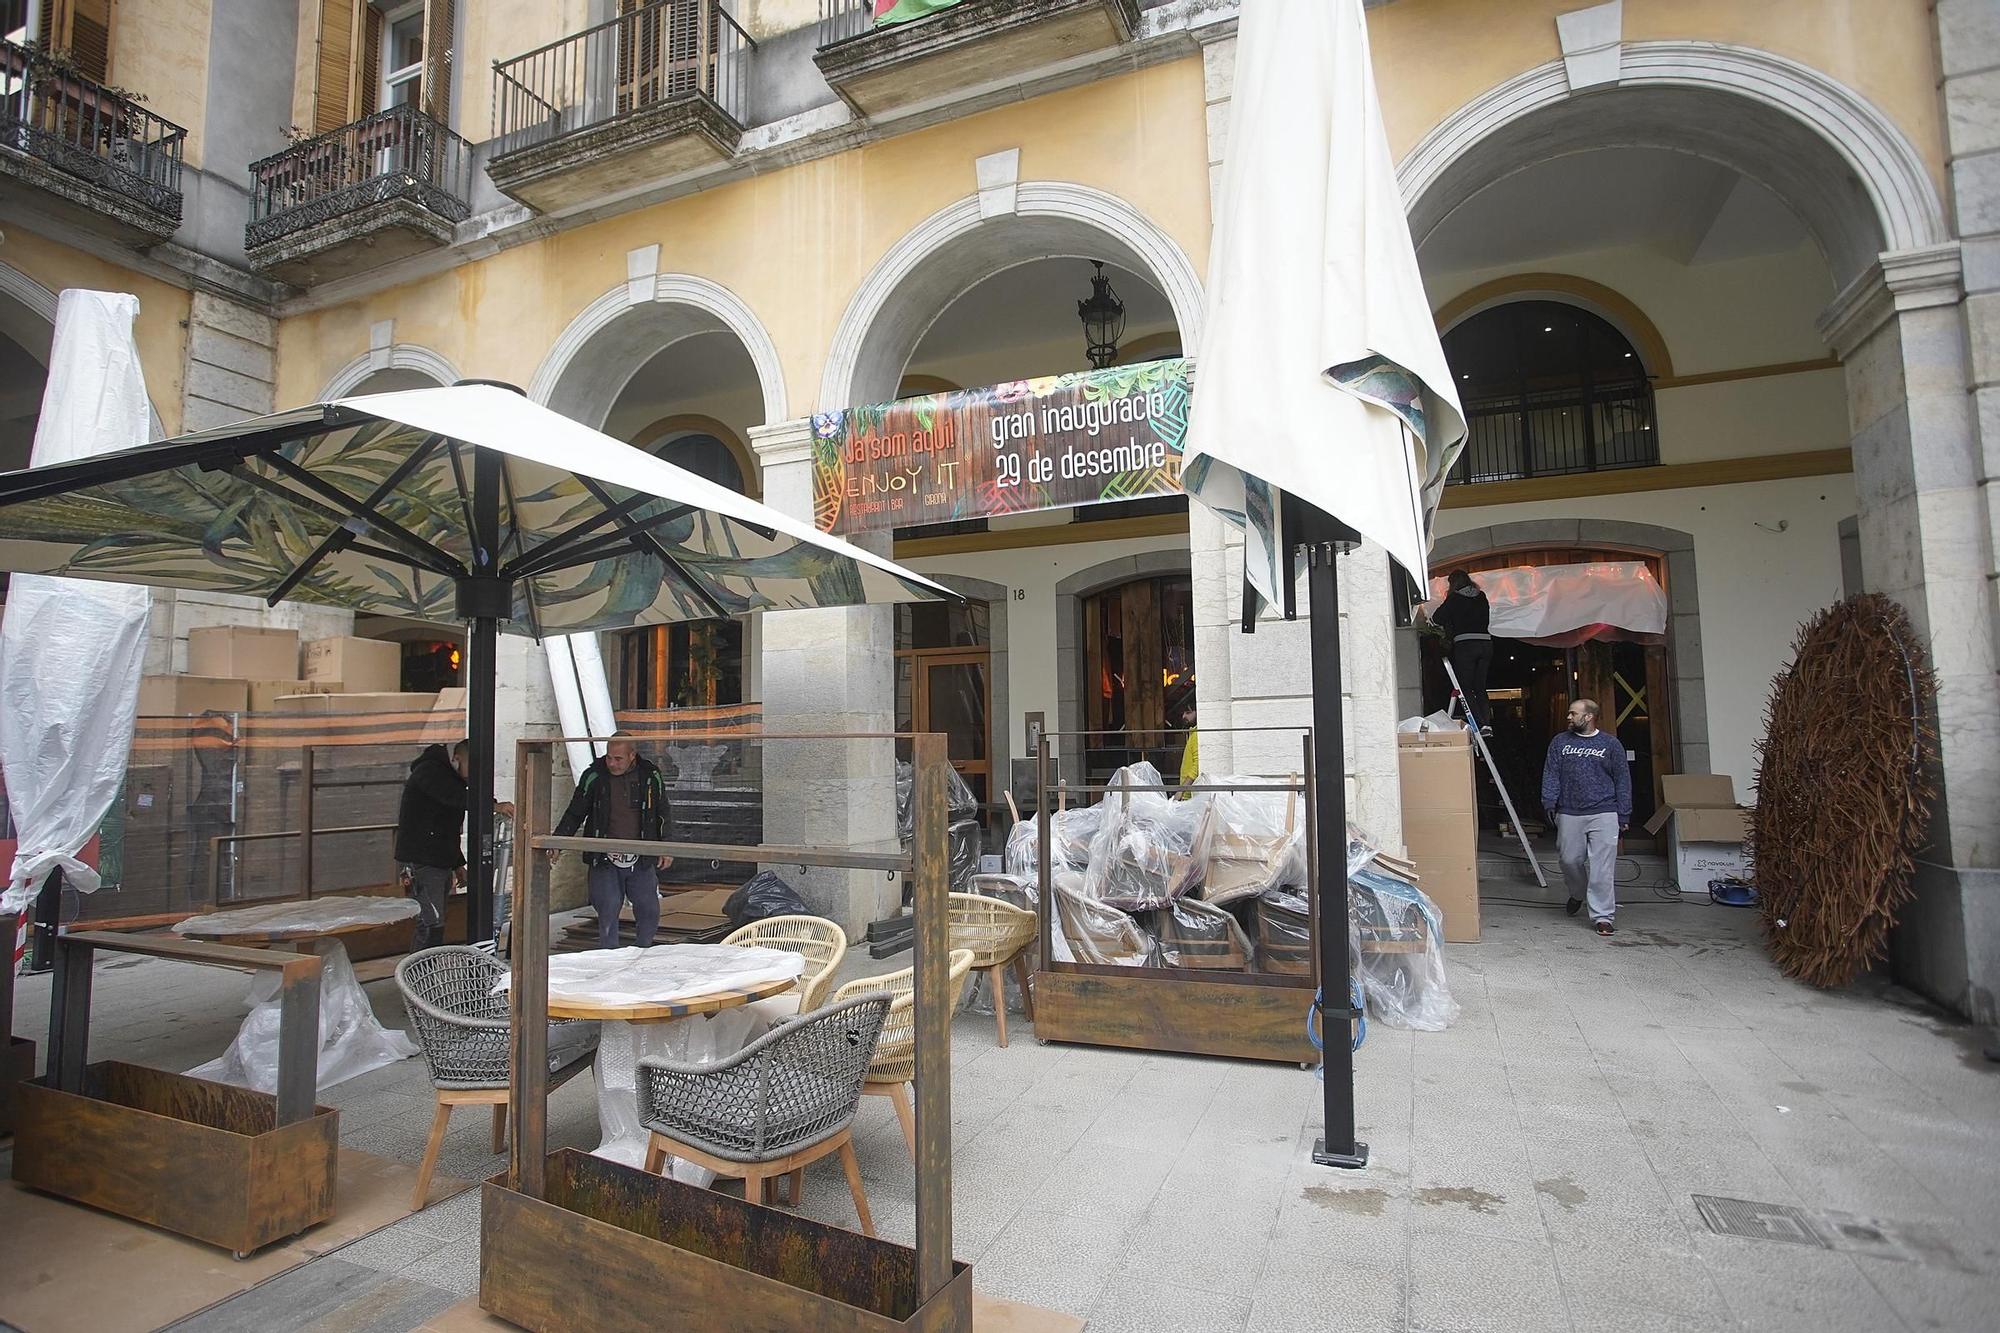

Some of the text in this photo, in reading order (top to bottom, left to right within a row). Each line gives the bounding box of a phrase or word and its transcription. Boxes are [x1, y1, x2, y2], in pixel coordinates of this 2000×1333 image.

[991, 411, 1036, 449] gran
[845, 434, 864, 464] Ja
[870, 432, 906, 460] som
[995, 436, 1166, 488] 29 de desembre
[846, 461, 960, 497] ENJOY IT
[891, 498, 904, 511] BAR
[1013, 588, 1026, 601] 18
[1561, 744, 1607, 758] Rugged
